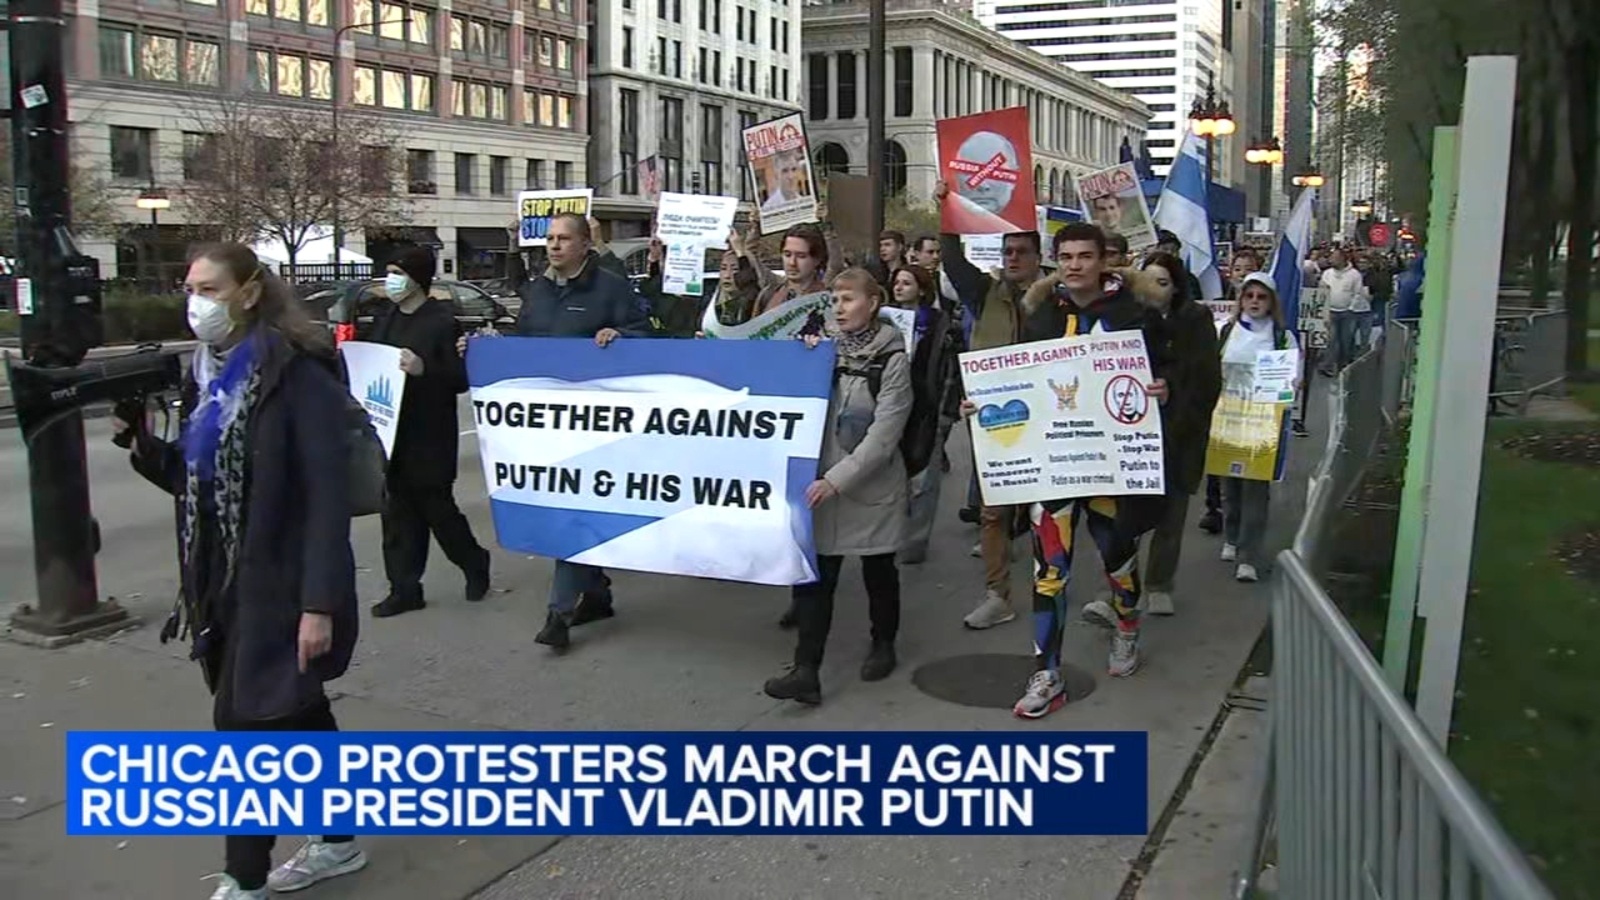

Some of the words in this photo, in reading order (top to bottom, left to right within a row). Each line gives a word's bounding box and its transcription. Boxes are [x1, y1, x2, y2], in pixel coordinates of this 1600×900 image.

[948, 160, 980, 172] RUSSIA
[968, 155, 1003, 187] WITHOUT
[992, 169, 1018, 181] PUTIN
[523, 199, 552, 217] STOP
[553, 197, 587, 216] PUTIN
[961, 351, 1031, 374] TOGETHER
[1032, 344, 1087, 363] AGAINTS
[1090, 339, 1120, 352] PUTIN
[1121, 338, 1142, 350] AND
[1093, 358, 1116, 372] HIS
[1117, 356, 1147, 371] WAR
[473, 401, 634, 433] TOGETHER
[642, 407, 804, 441] AGAINST
[1069, 420, 1094, 428] Russian
[1045, 430, 1074, 440] Political
[1113, 433, 1133, 443] Stop
[1135, 432, 1160, 440] Putin
[1122, 444, 1142, 454] Stop
[1144, 444, 1160, 452] War
[987, 460, 1003, 468] We
[1005, 457, 1032, 467] want
[1119, 460, 1146, 472] Putin
[1149, 460, 1160, 471] to
[982, 466, 1041, 479] Democracy
[494, 462, 581, 494] PUTIN
[593, 470, 616, 497] &
[625, 472, 682, 503] HIS
[692, 476, 772, 510] WAR
[990, 480, 1001, 488] in
[1003, 476, 1038, 487] Russia
[1125, 478, 1143, 489] the
[1144, 477, 1160, 489] Jail
